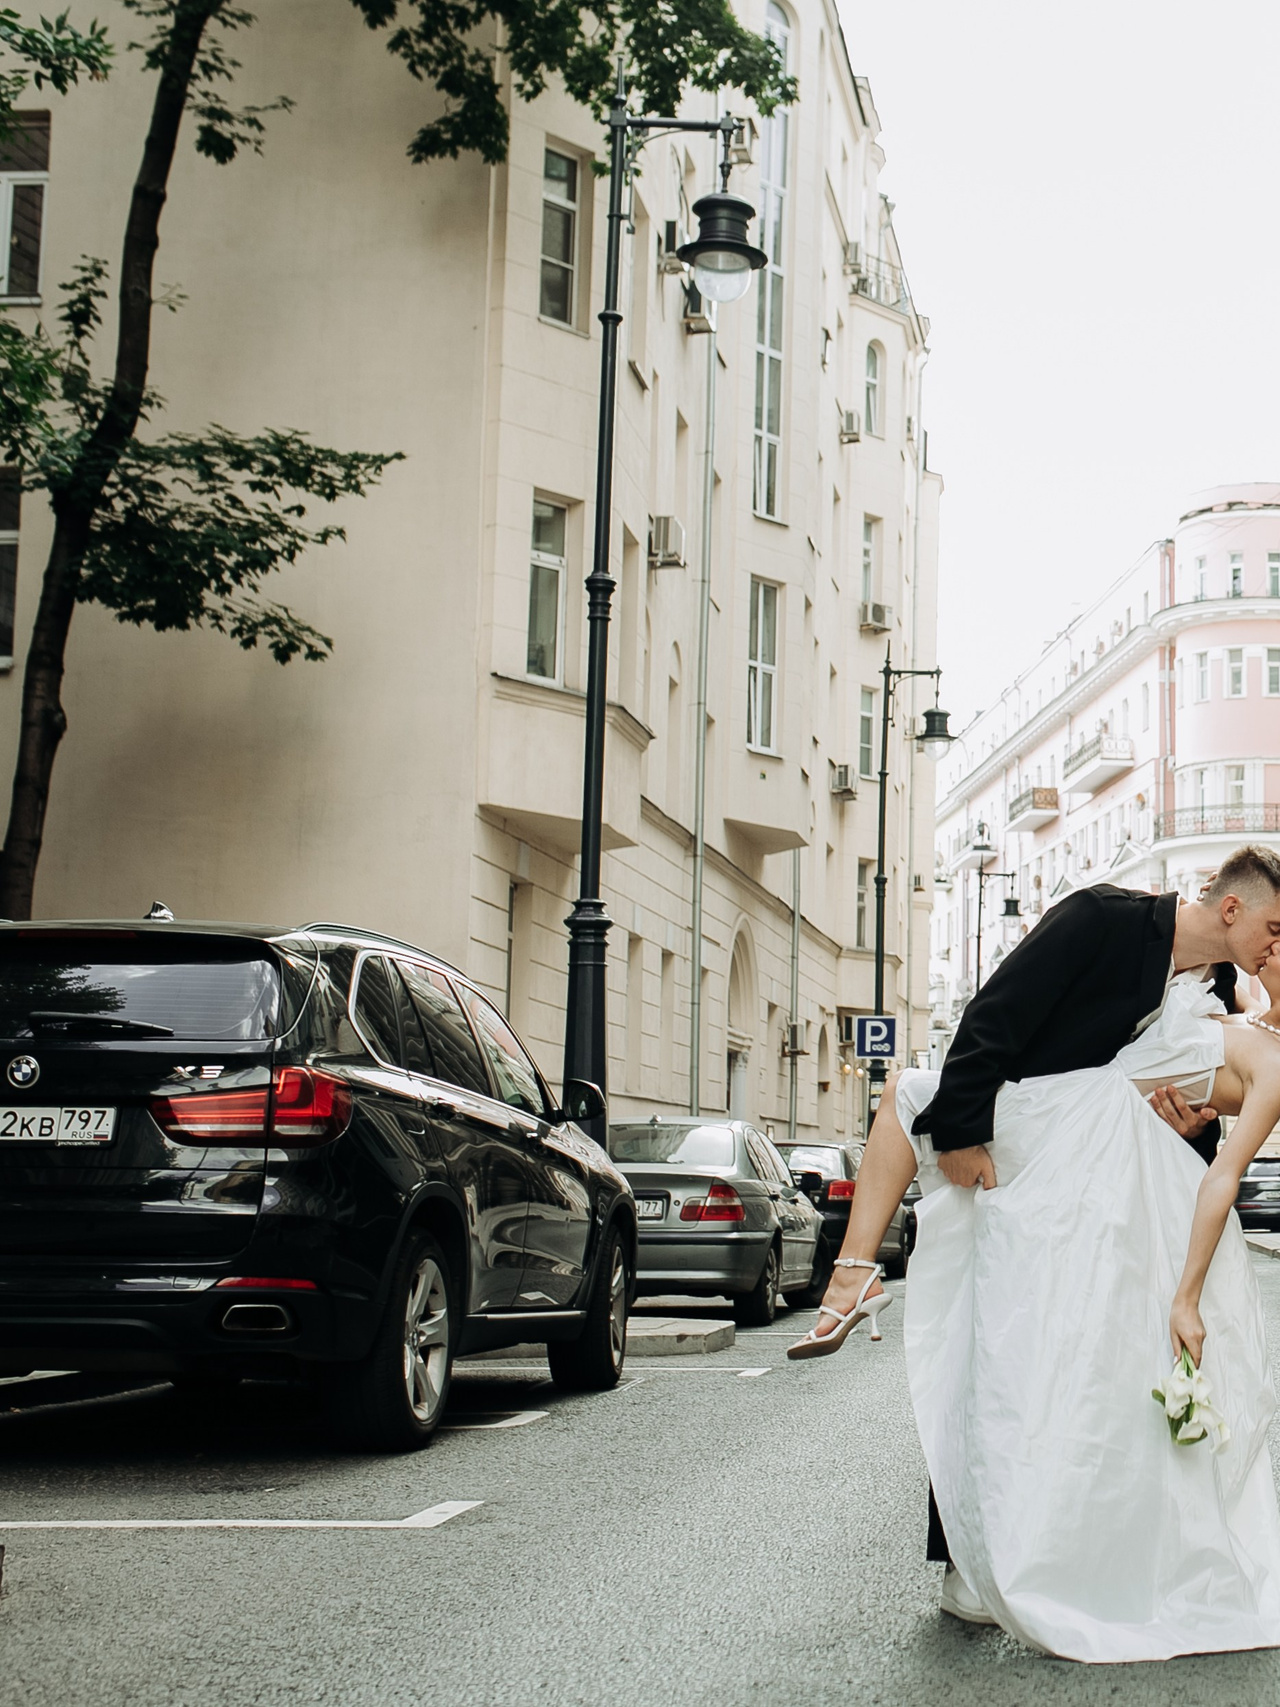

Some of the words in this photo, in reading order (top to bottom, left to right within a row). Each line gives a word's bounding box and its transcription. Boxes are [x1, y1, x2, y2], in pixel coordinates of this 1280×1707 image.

[865, 1020, 888, 1053] P
[63, 1110, 107, 1130] 797
[71, 1131, 93, 1139] RUS
[645, 1201, 658, 1211] 77
